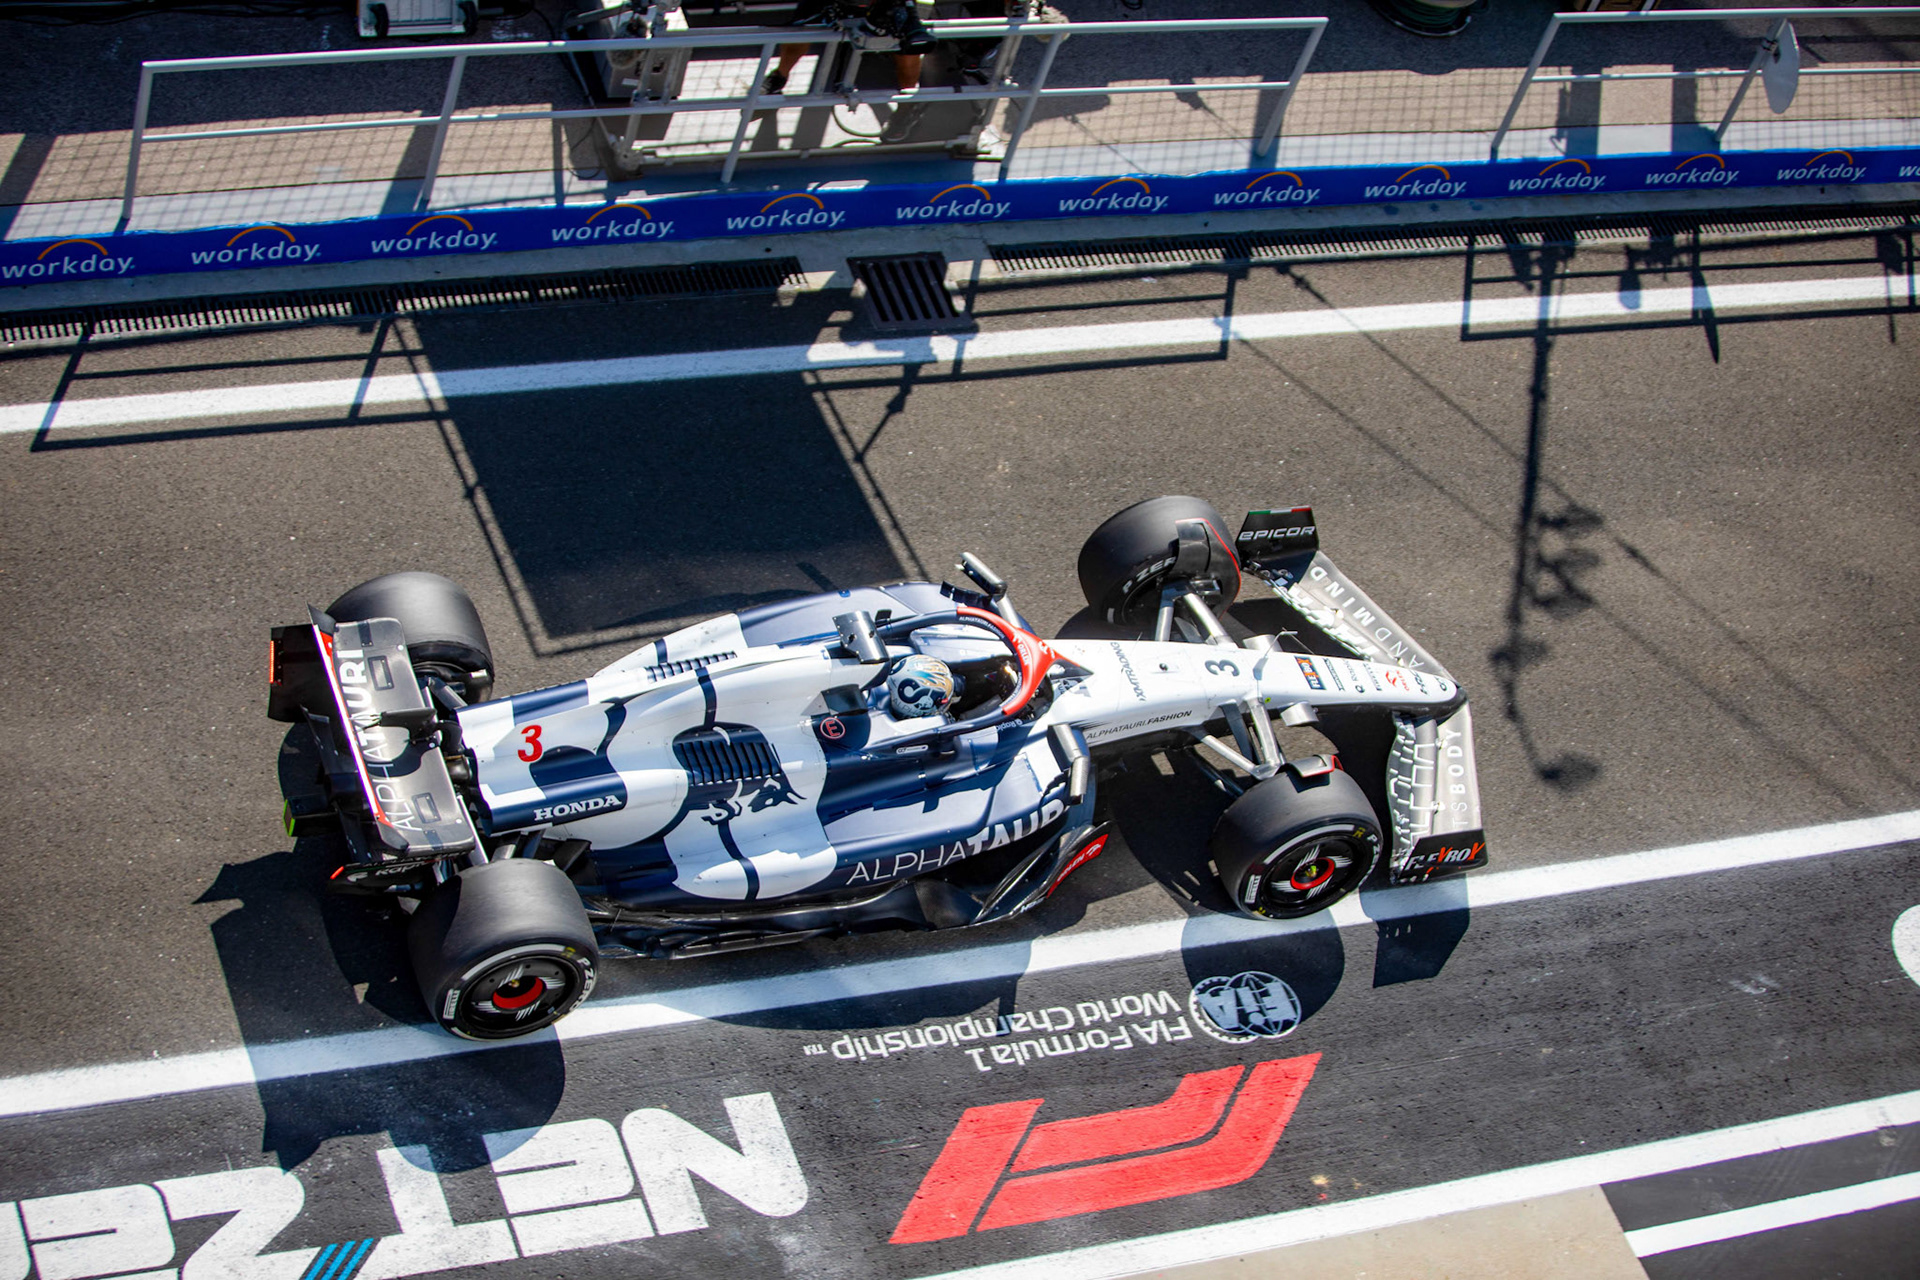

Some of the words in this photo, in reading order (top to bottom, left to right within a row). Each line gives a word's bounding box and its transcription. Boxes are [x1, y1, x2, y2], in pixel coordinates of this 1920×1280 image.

[1364, 178, 1464, 198] workday
[1508, 171, 1604, 191] workday
[1645, 167, 1737, 187] workday
[896, 196, 1007, 220] workday
[1059, 188, 1166, 212] workday
[1214, 184, 1318, 206] workday
[551, 215, 671, 241] workday
[726, 205, 843, 230] workday
[191, 238, 317, 265] workday
[371, 227, 495, 253] workday
[1, 252, 133, 279] workday
[1238, 525, 1316, 541] EPICOR
[1135, 556, 1177, 582] ZER
[1309, 566, 1376, 627] MIND
[1374, 626, 1425, 669] AND
[1204, 658, 1241, 677] 3
[825, 719, 841, 738] E
[1085, 710, 1193, 741] ALPHATAURI.FASHION
[517, 724, 543, 763] 3
[533, 794, 623, 821] HONDA
[845, 799, 1066, 886] ALPHATAUR
[1085, 989, 1183, 1022] World
[832, 1004, 1073, 1062] Championship
[1132, 1015, 1193, 1046] FIA
